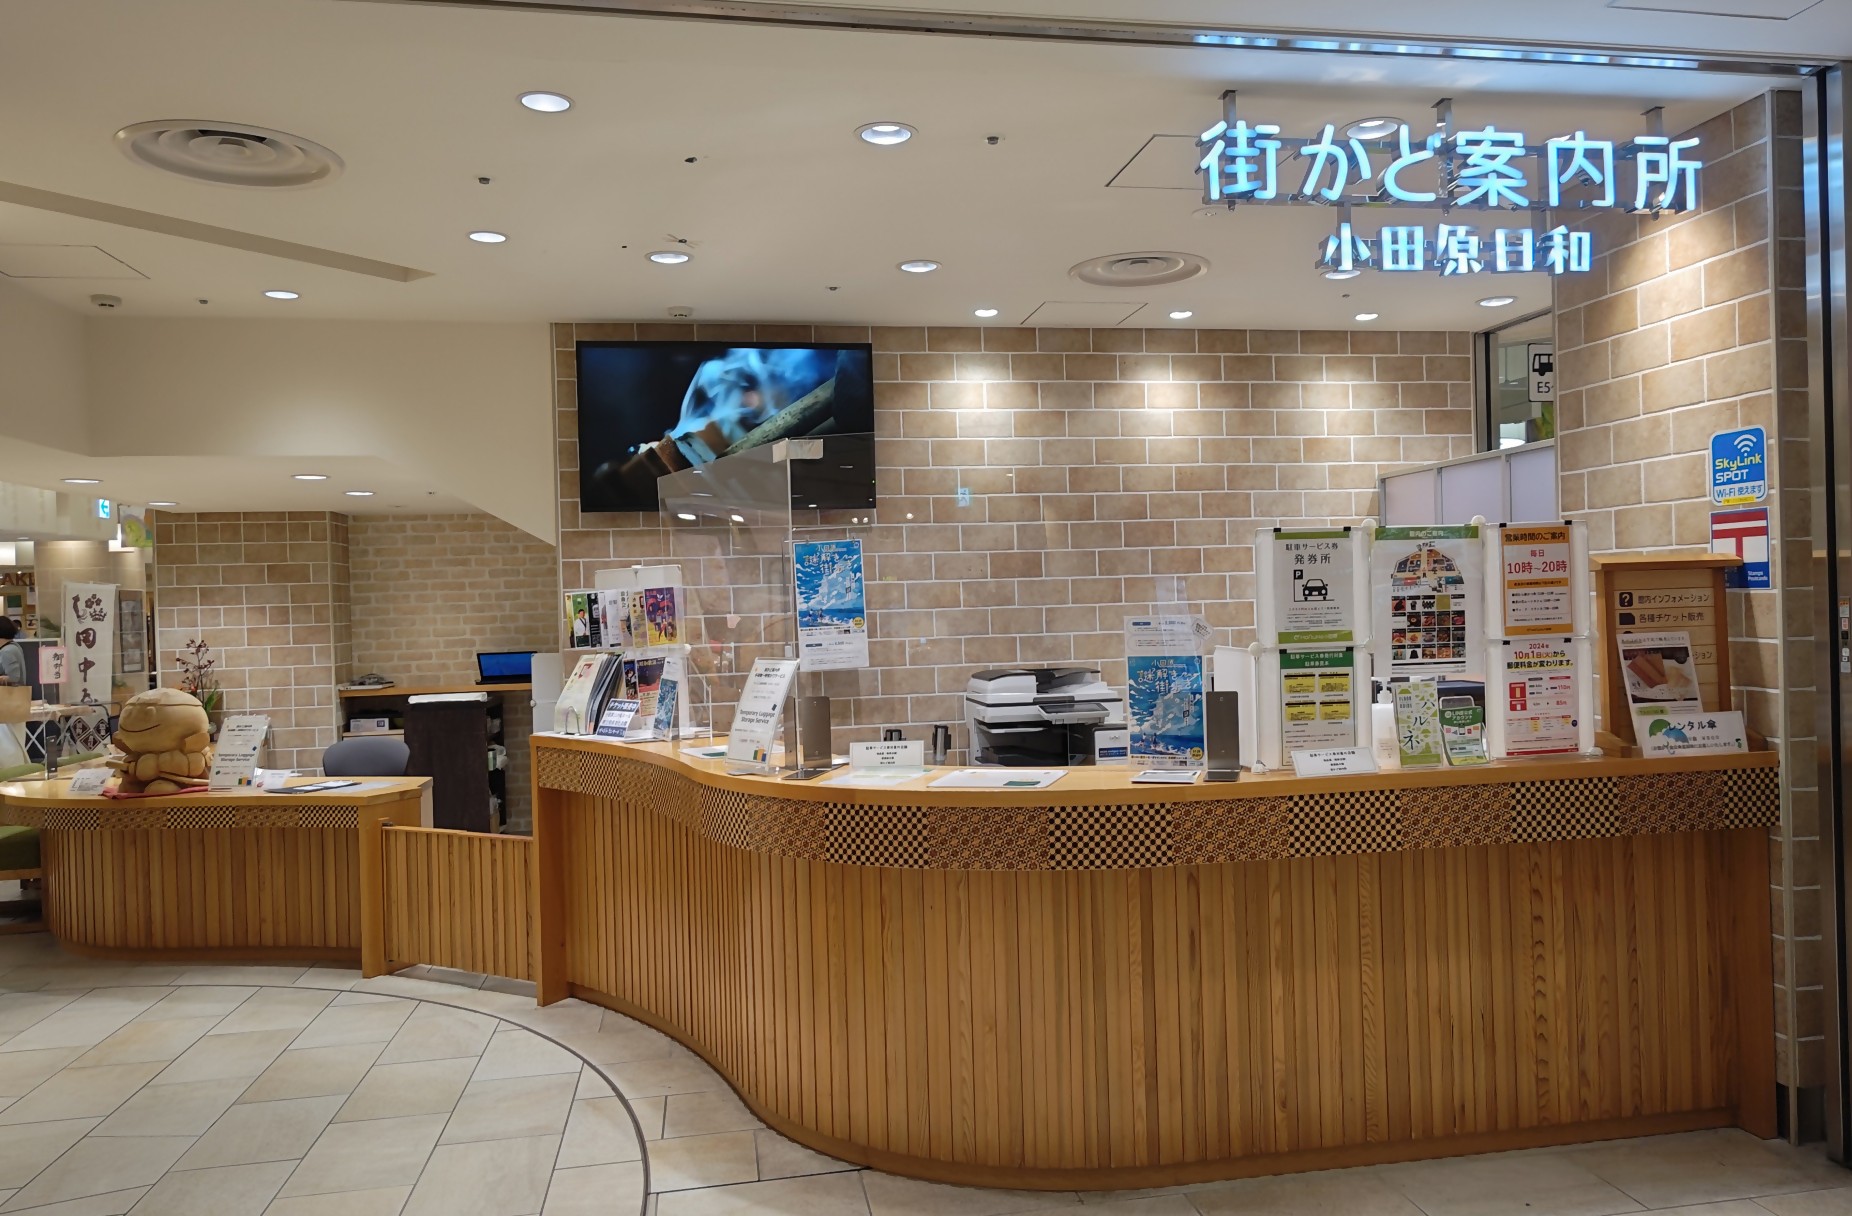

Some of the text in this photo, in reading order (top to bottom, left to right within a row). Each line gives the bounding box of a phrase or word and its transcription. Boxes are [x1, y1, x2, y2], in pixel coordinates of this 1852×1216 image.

[1200, 120, 1703, 211] 街かど案内所
[1323, 222, 1593, 276] 小田原日和
[1537, 381, 1553, 393] E5
[1715, 453, 1762, 471] SkyLink
[1715, 469, 1749, 483] SPOT
[1716, 485, 1763, 498] Wi-Fi 使えます
[1504, 532, 1566, 542] 営業時間のご案内
[1285, 542, 1338, 551] 駐車サービス券
[1294, 553, 1331, 565] 発券所
[1530, 549, 1545, 557] 毎日
[1639, 612, 1704, 623] 各種チケット販売
[1506, 659, 1573, 669] 郵便料金が変わります。
[1402, 701, 1436, 750] ハルネ
[1668, 718, 1717, 730] レンタル傘
